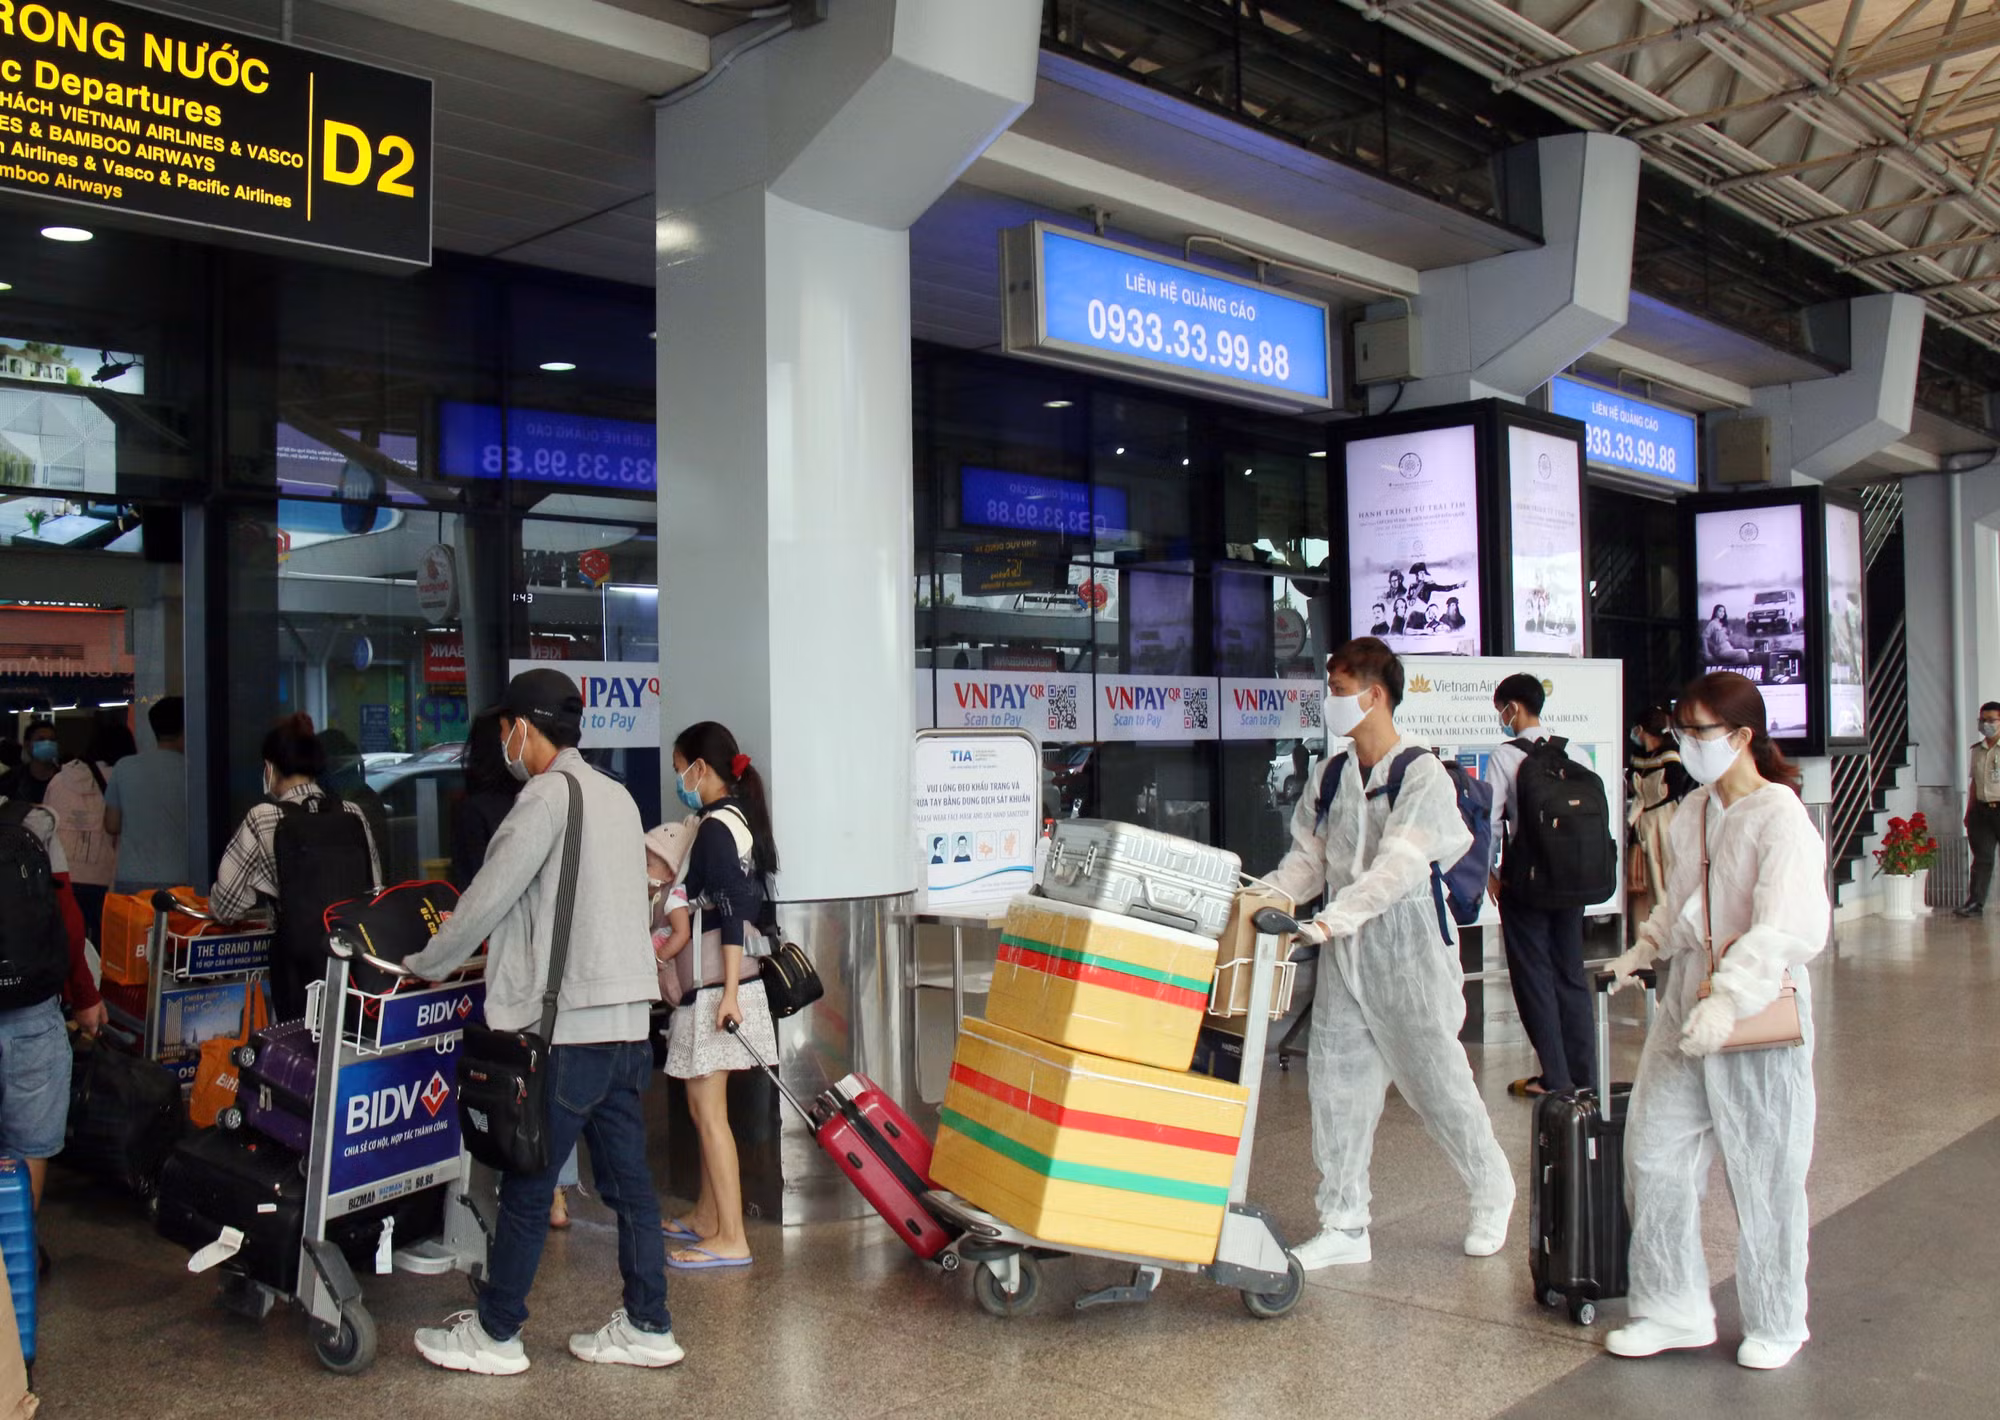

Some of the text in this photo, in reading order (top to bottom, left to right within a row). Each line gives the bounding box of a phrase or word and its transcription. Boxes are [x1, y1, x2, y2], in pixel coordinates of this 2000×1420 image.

[144, 33, 270, 94] NƯỚC
[36, 60, 222, 127] Departures
[29, 122, 42, 138] &
[50, 126, 130, 155] BAMBOO
[136, 145, 215, 172] AIRWAYS
[60, 104, 140, 135] VIETNAM
[147, 124, 224, 152] AIRLINES
[230, 141, 242, 157] &
[247, 144, 303, 168] VASCO
[323, 119, 415, 198] D2
[11, 142, 77, 168] Airlines
[84, 155, 97, 170] &
[103, 160, 154, 182] Vasco
[160, 170, 171, 186] &
[177, 174, 229, 197] Pacific
[235, 185, 291, 208] Airlines
[54, 174, 123, 199] Airways
[1126, 272, 1256, 322] LIÊN HỆ QUẢNG CÁO
[1088, 300, 1290, 381] 0933.33.99.88
[1592, 400, 1608, 416] LIÊN
[1644, 416, 1658, 432] CÁO
[1586, 423, 1676, 473] 933.33.99.88
[1434, 680, 1499, 692] Vietnam Airli
[590, 713, 635, 732] to Pay
[965, 712, 1021, 728] Scan to Pay
[1114, 713, 1161, 728] Scan to Pay
[1240, 713, 1281, 727] Scan to Pay
[1556, 714, 1588, 722] AIRLINES
[1446, 728, 1478, 736] AIRLINES
[950, 750, 972, 761] TIA
[927, 785, 938, 793] VUI
[958, 784, 970, 792] ĐEO
[990, 782, 1010, 790] TRANG
[930, 798, 942, 807] TAY
[197, 944, 215, 957] THE
[218, 941, 250, 956] GRAND
[417, 998, 457, 1027] BIDV
[346, 1080, 421, 1135] BIDV
[344, 1146, 358, 1157] CHIA
